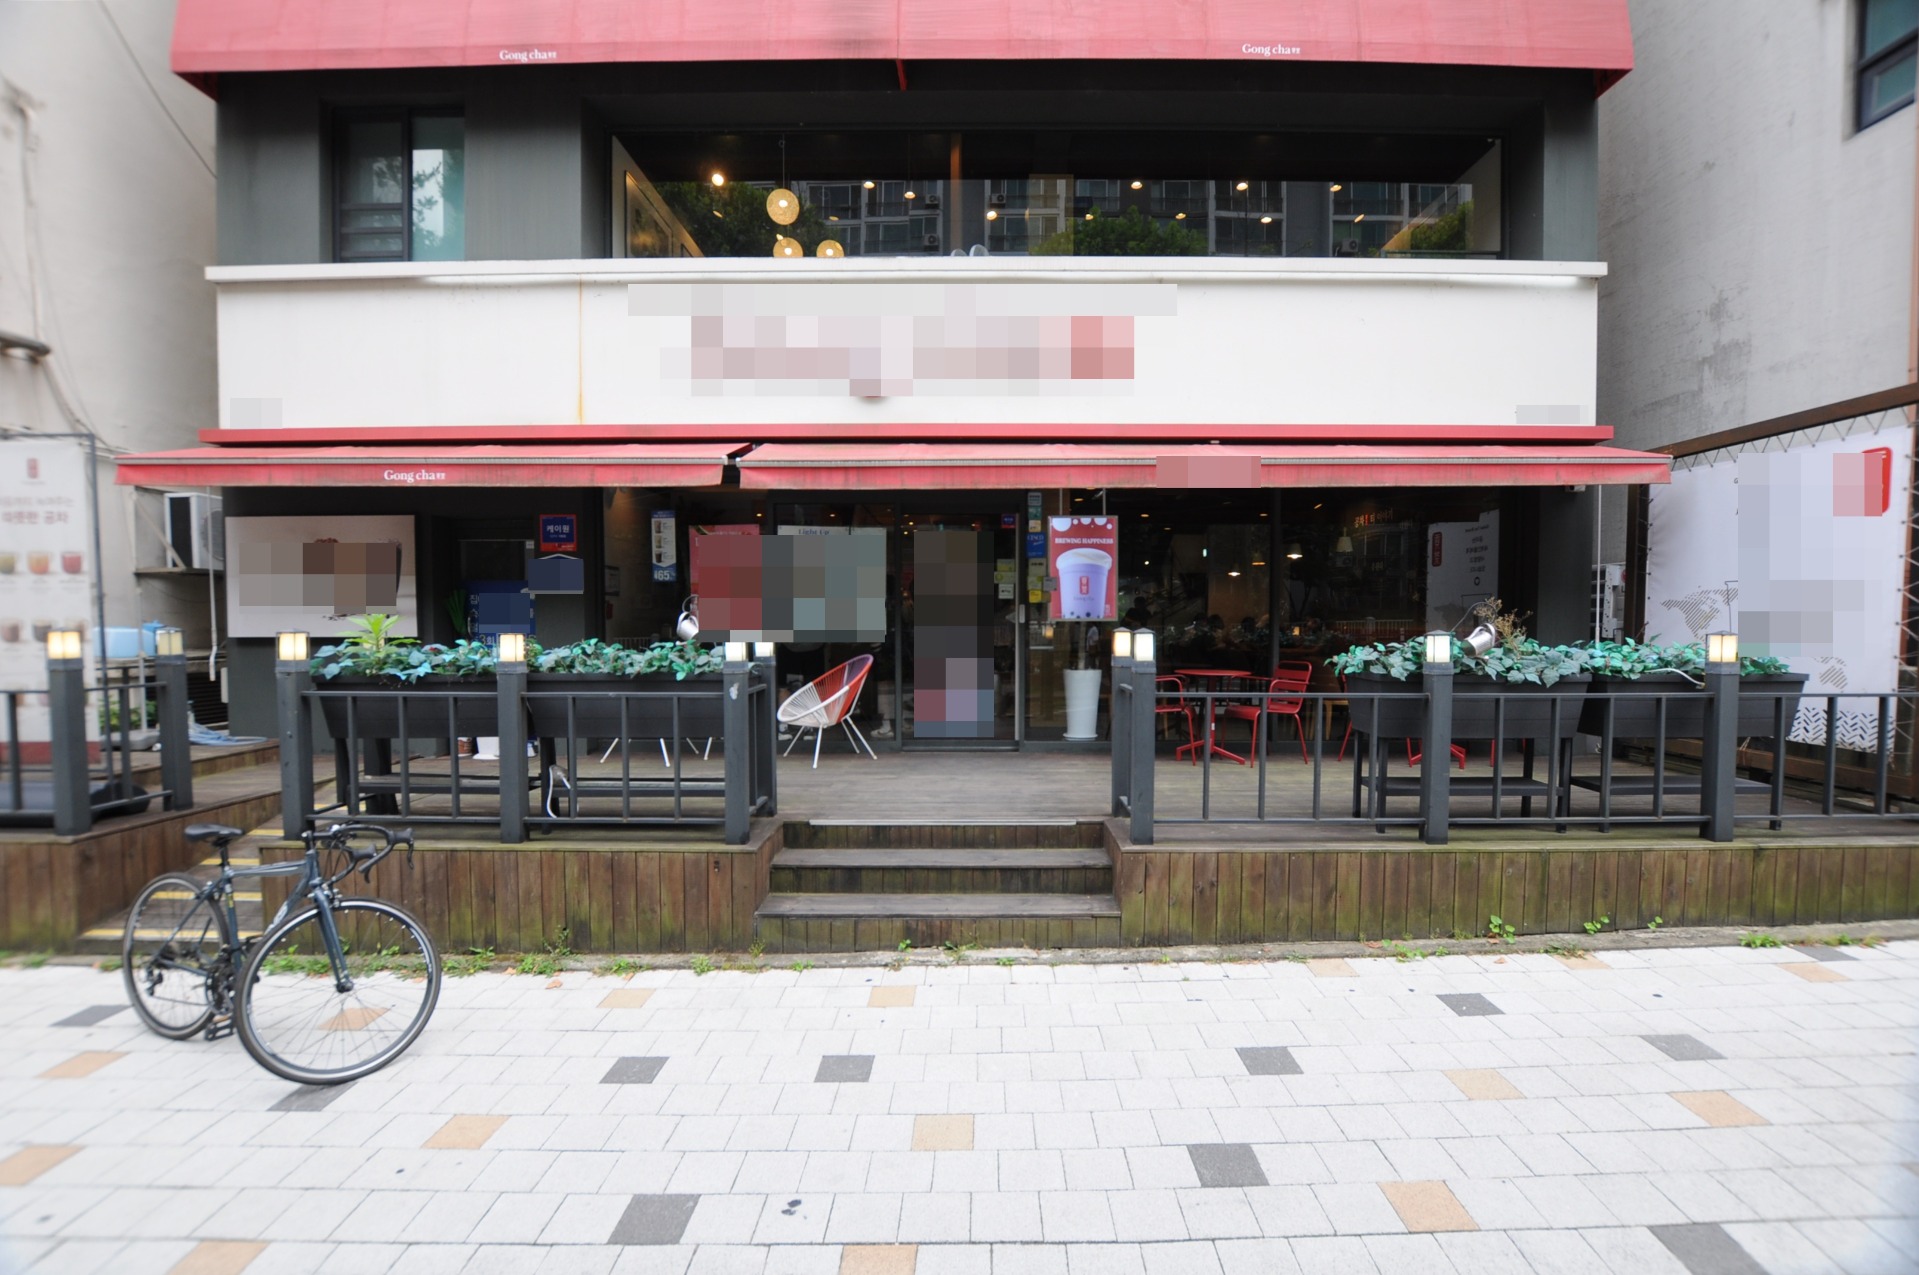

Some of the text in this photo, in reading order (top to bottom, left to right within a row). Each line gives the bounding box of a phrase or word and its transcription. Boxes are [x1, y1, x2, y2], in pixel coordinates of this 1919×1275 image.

[499, 49, 528, 63] Gong
[529, 48, 547, 59] cha
[1242, 43, 1271, 57] Gong
[1272, 43, 1291, 55] cha
[383, 469, 414, 483] Gong
[415, 468, 436, 480] cha
[546, 524, 570, 533] 케이원
